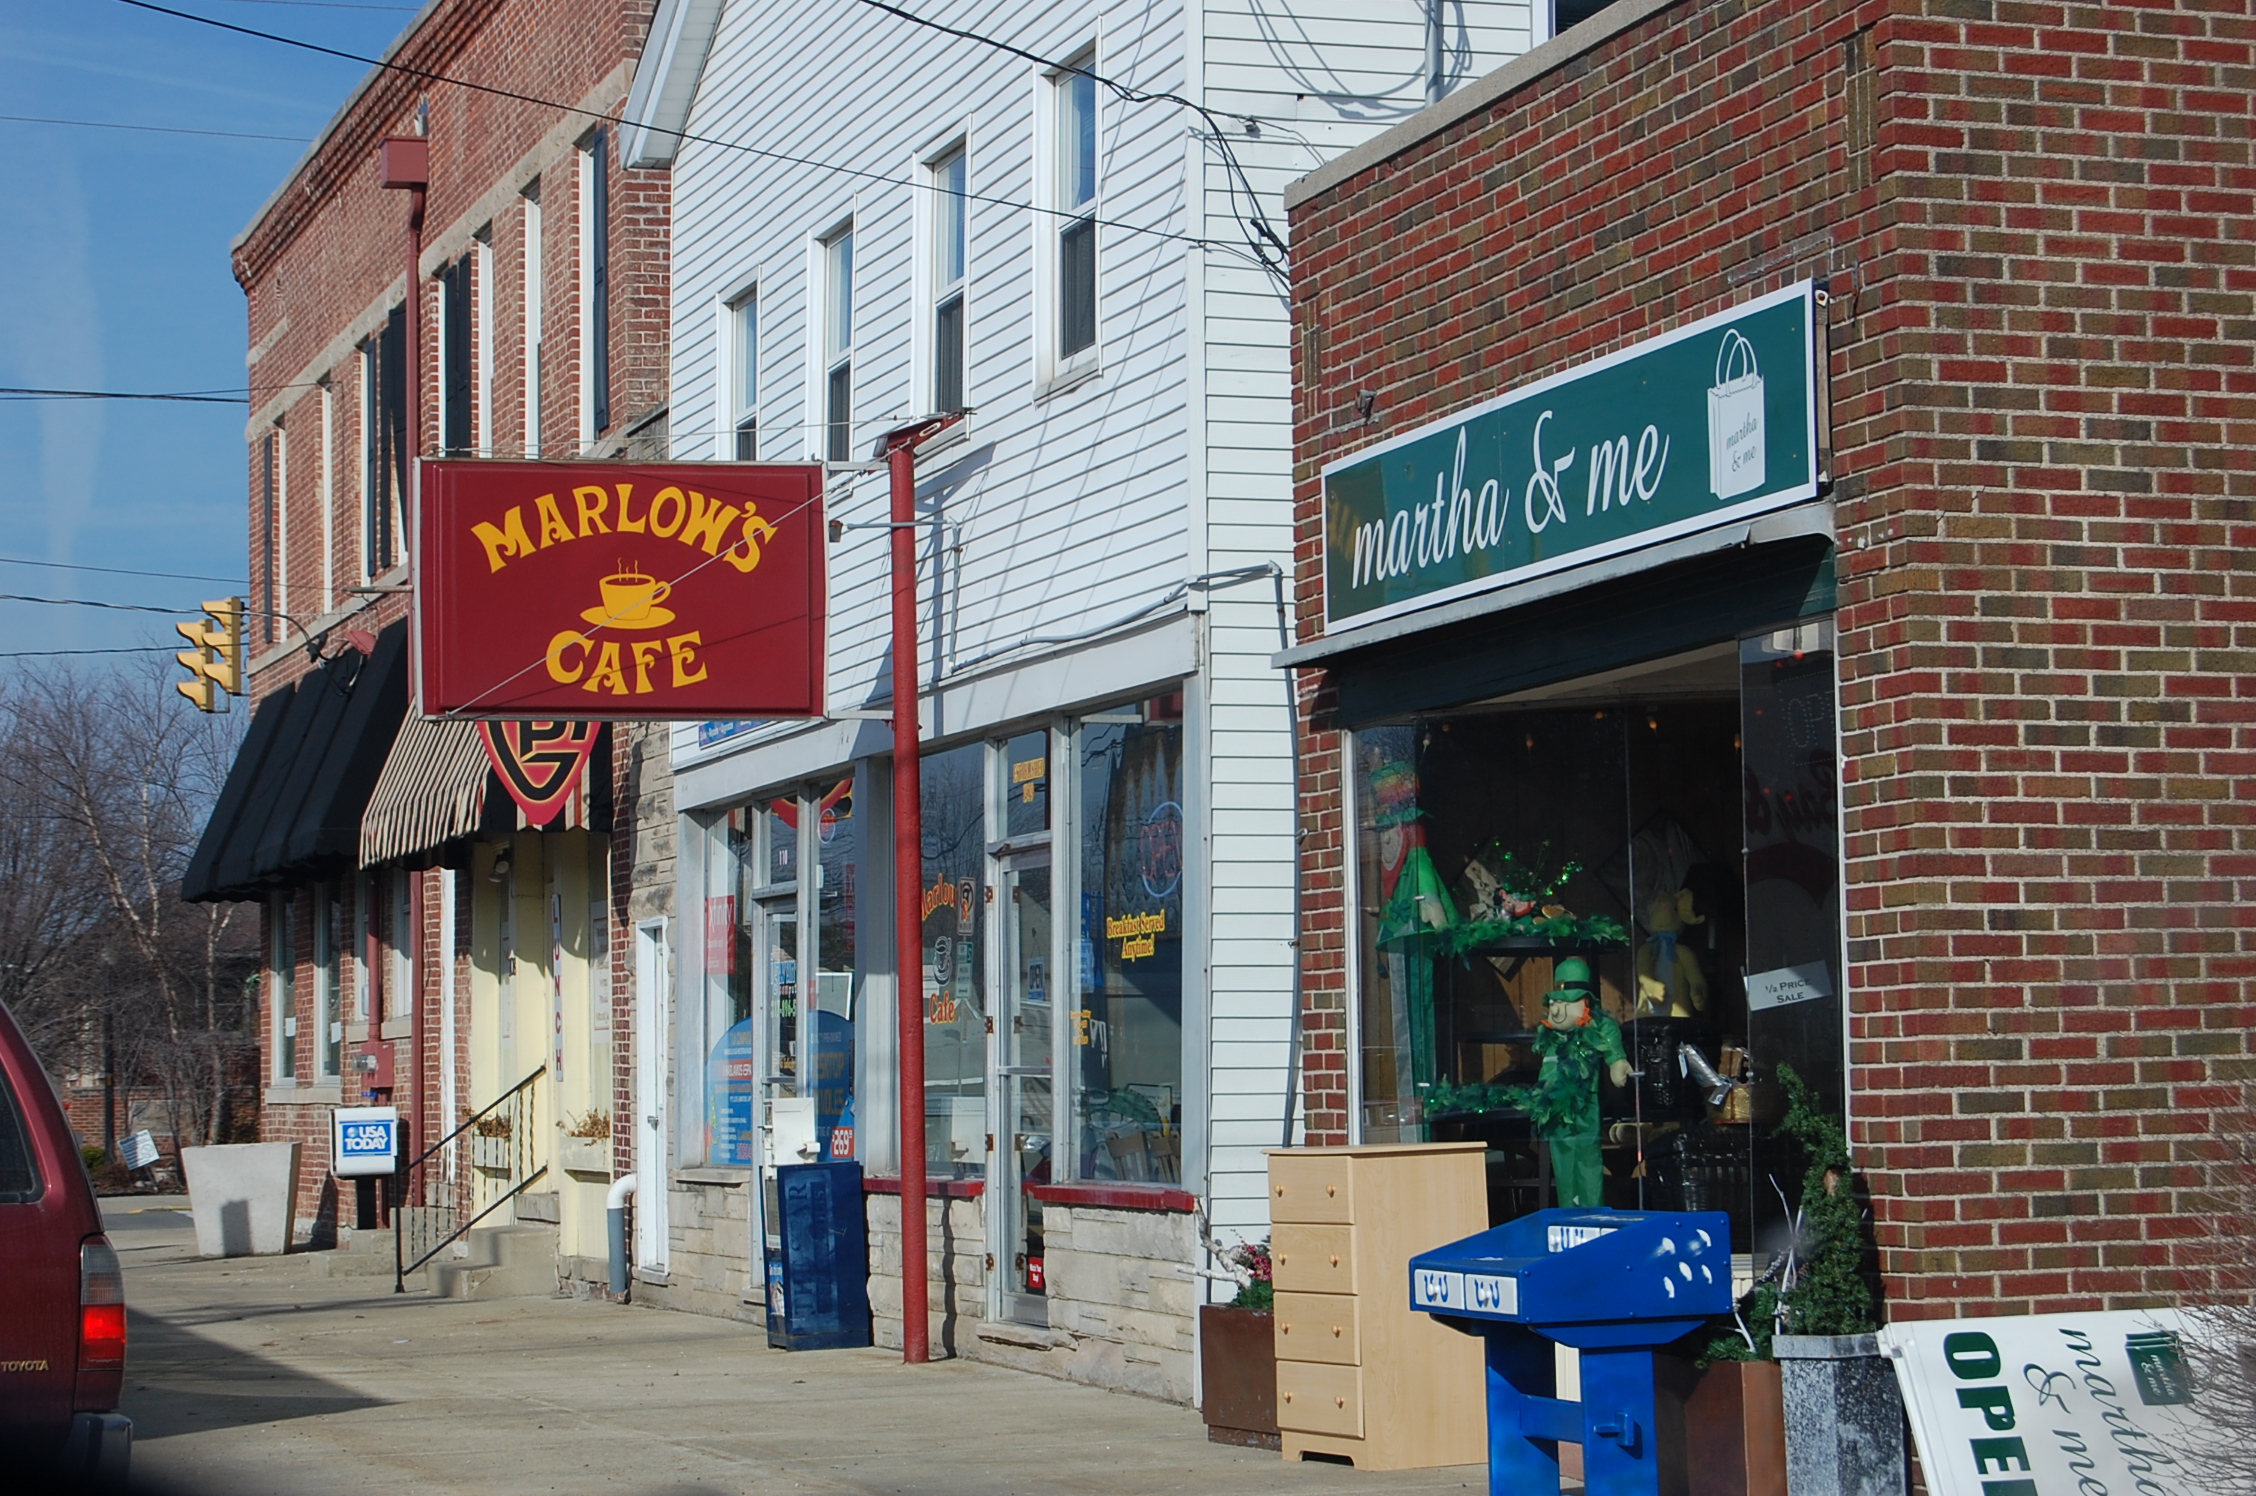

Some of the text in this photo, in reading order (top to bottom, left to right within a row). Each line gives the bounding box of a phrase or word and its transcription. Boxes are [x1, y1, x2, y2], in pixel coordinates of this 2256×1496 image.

[1725, 411, 1759, 452] martha
[1731, 445, 1757, 473] & me
[1351, 409, 1670, 590] martha & me
[470, 482, 779, 574] MARLOW'S
[545, 629, 708, 695] CAFE
[1106, 908, 1166, 939] Breakfast Served
[1121, 933, 1155, 962] Anytime!
[552, 901, 563, 1072] LUNCH
[1776, 991, 1805, 1004] SALE
[1779, 979, 1812, 991] PRICE
[929, 990, 955, 1025] Cafe
[344, 1136, 389, 1151] TODAY
[358, 1125, 387, 1138] USA
[1, 1360, 50, 1373] TOYOTA
[2023, 1363, 2109, 1496] & me
